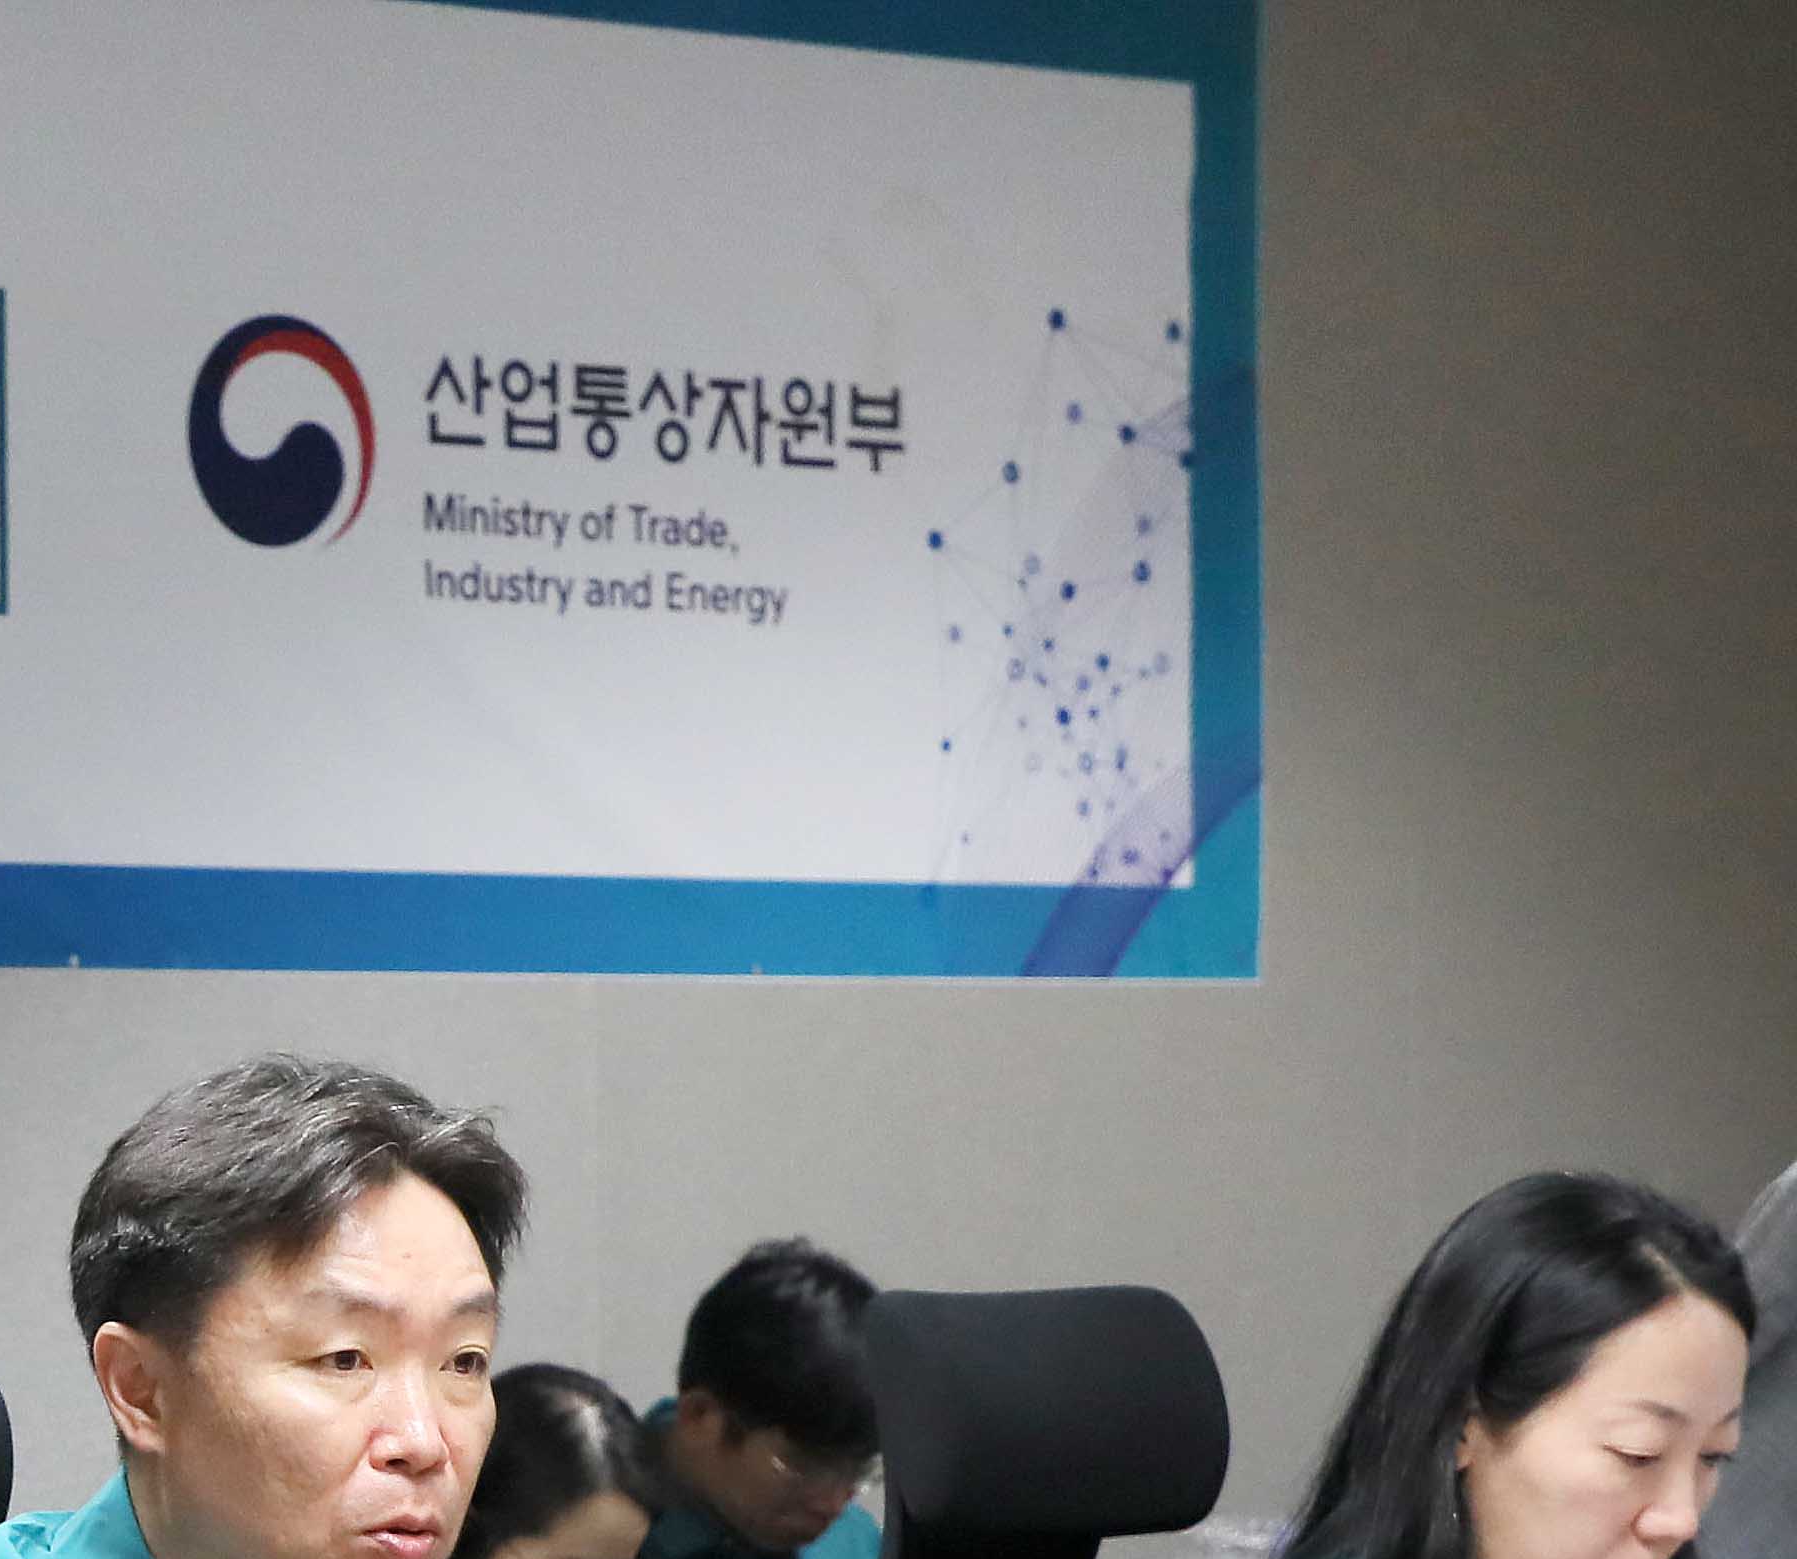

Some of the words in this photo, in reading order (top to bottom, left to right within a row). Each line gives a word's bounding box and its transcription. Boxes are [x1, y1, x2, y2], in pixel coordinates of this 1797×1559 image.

[424, 353, 905, 473] 산업통상자원부
[423, 493, 568, 549] Ministry
[580, 502, 615, 541] of
[632, 505, 740, 553] Trade,
[424, 560, 572, 614] Industry
[583, 571, 652, 611] and
[665, 573, 788, 625] Energy
